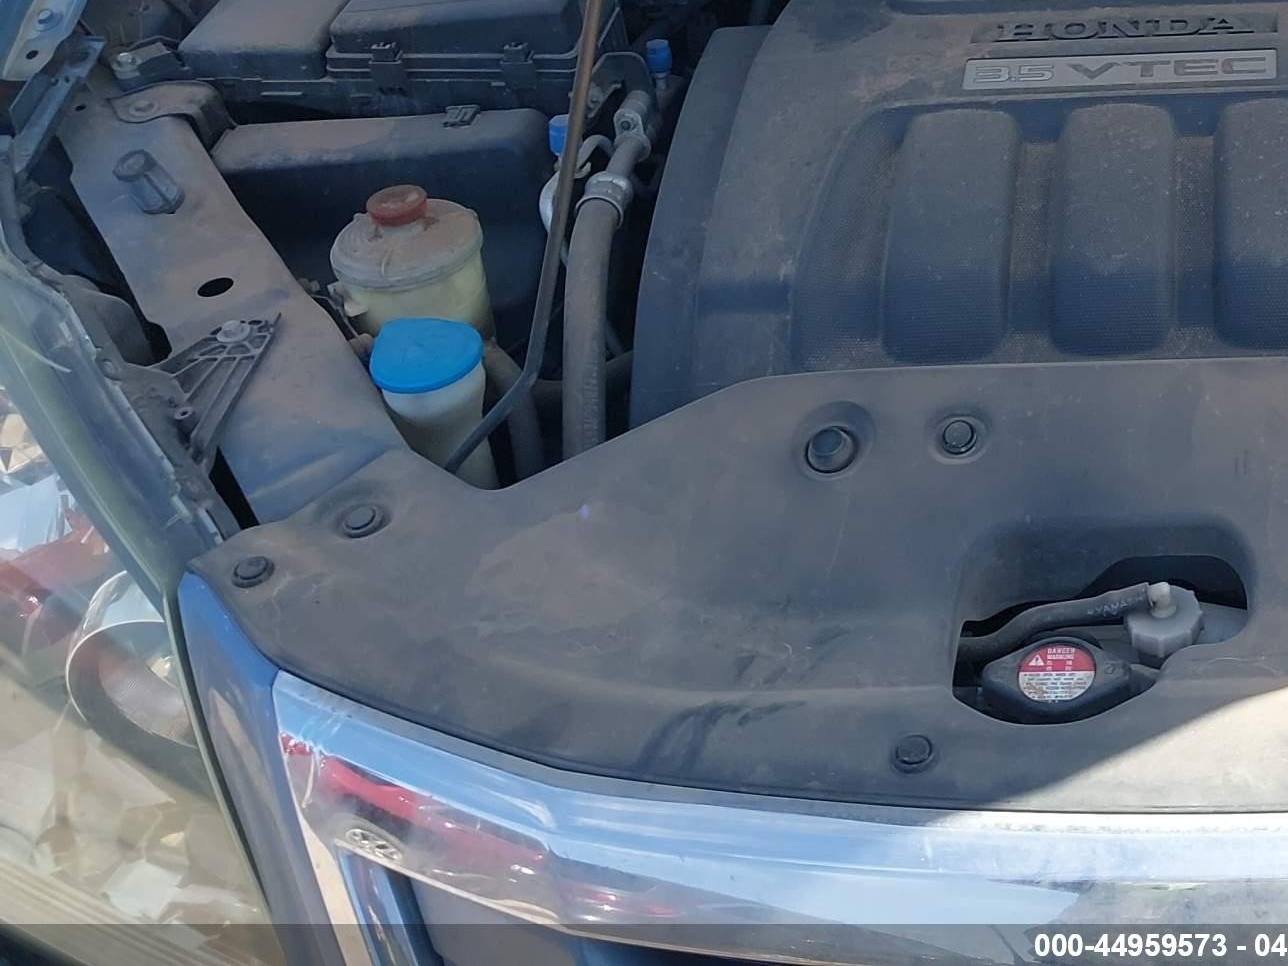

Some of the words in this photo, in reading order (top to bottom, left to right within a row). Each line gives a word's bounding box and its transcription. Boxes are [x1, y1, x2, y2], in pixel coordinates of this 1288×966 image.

[994, 16, 1255, 43] HONDA
[973, 64, 1054, 84] 3.5
[1066, 55, 1267, 81] VTEC
